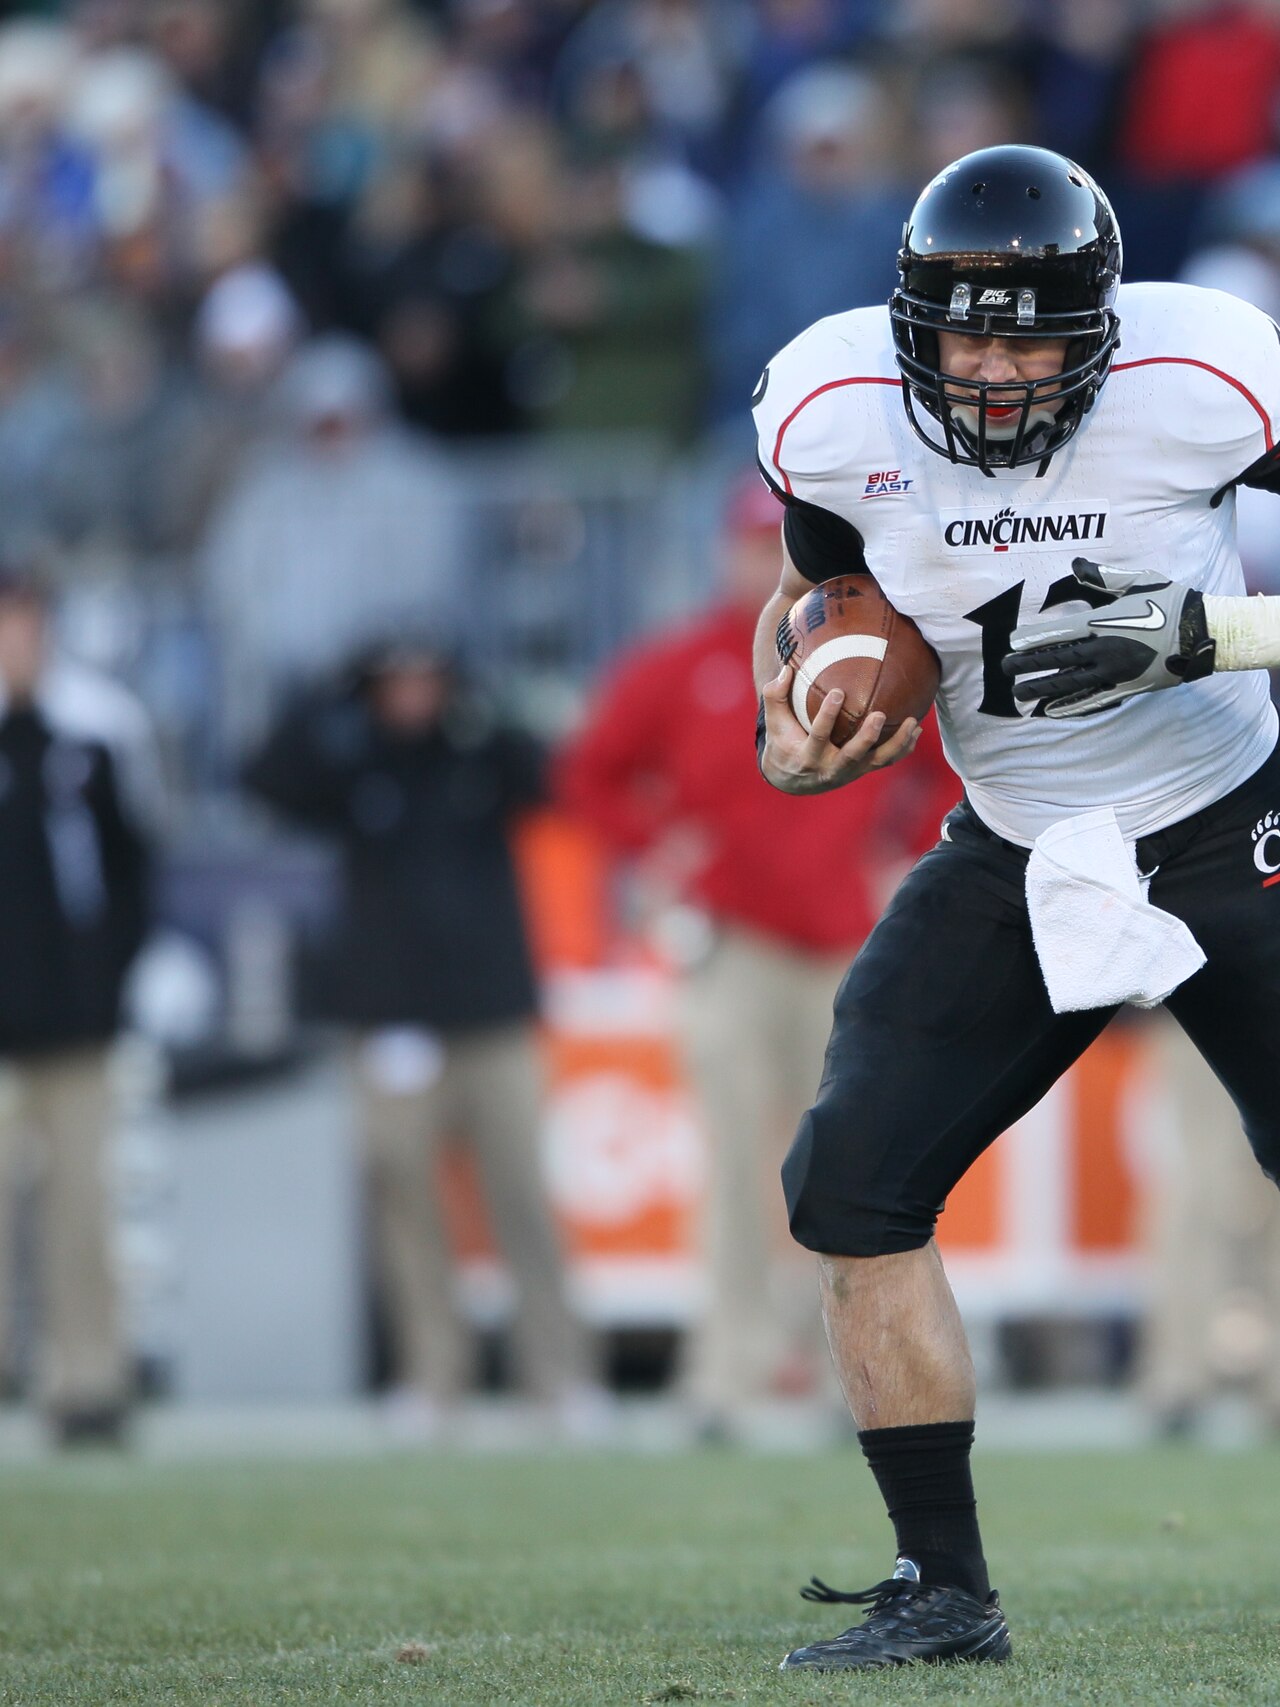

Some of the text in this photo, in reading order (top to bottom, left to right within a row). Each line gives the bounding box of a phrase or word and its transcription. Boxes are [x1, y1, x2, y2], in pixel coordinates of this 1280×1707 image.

[983, 289, 1007, 297] BIG
[979, 296, 1012, 304] EAST
[867, 470, 901, 484] BIG
[864, 480, 914, 493] EAST
[944, 512, 1107, 547] CINCINNATI
